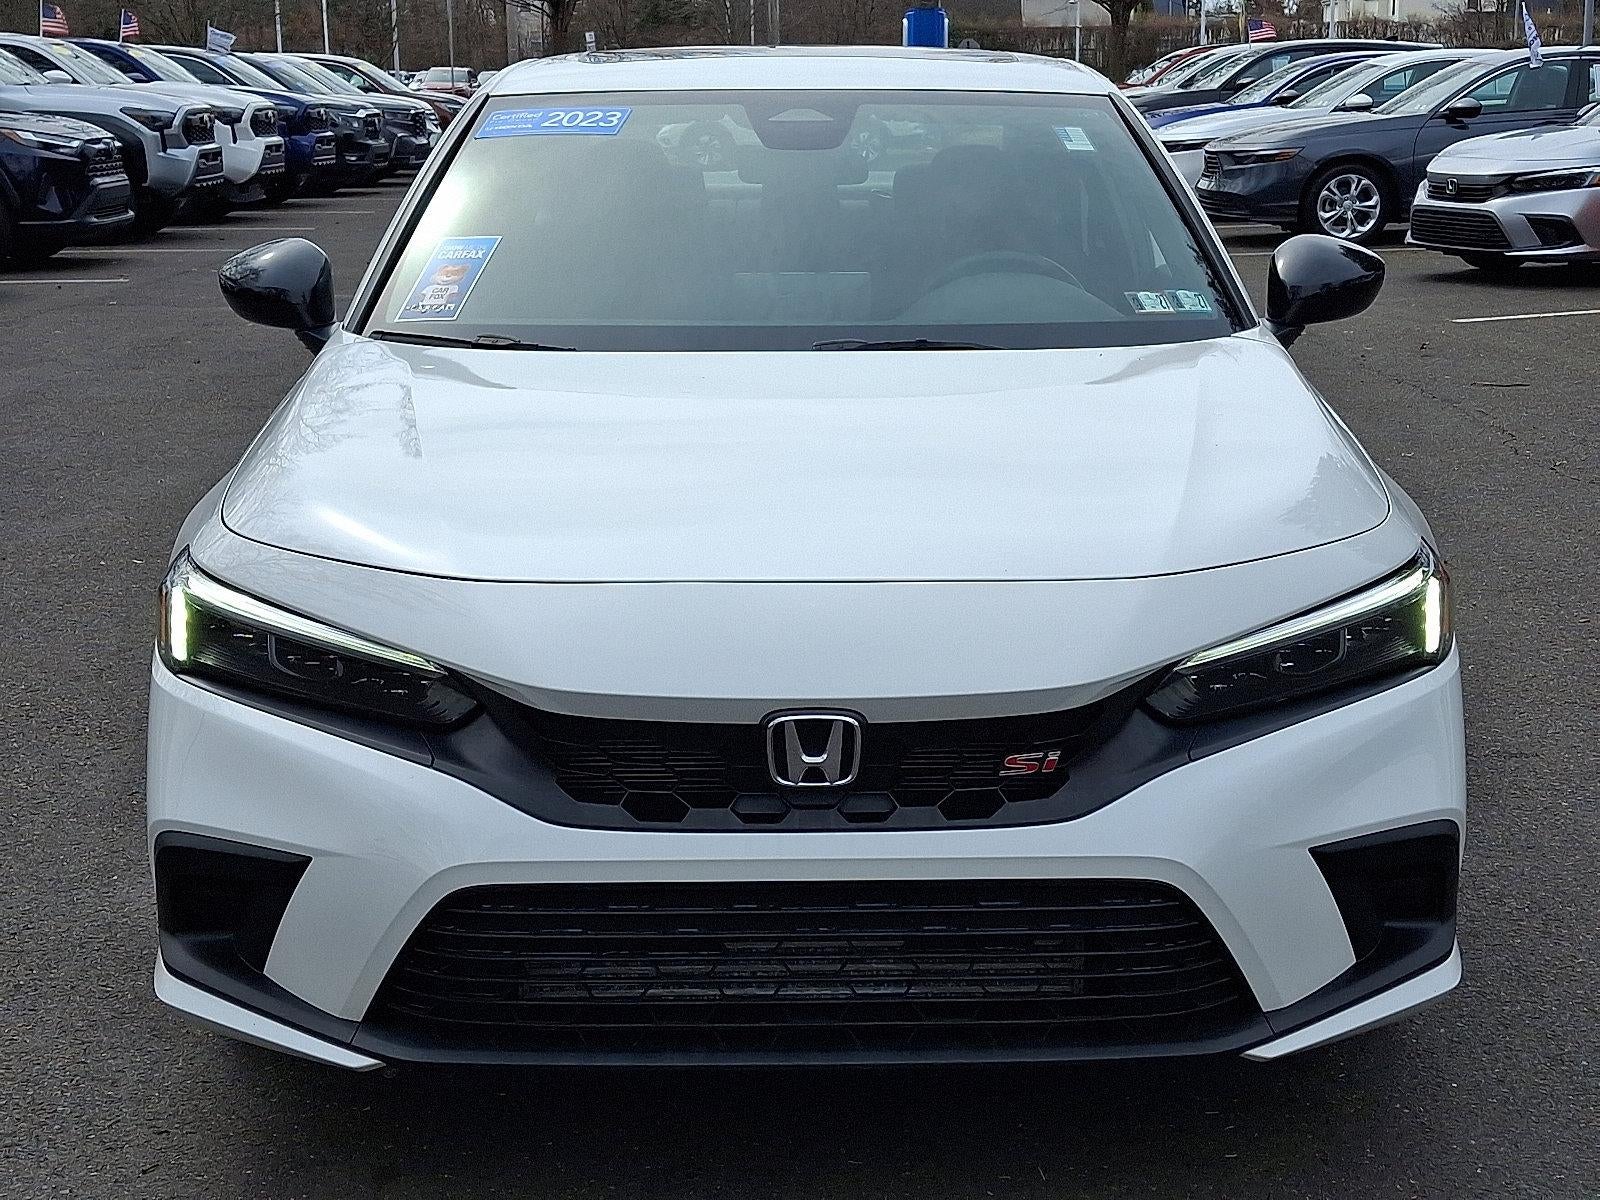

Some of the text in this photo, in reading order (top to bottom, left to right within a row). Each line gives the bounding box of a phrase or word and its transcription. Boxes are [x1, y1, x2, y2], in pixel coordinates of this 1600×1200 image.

[492, 111, 544, 121] Certified
[540, 111, 622, 128] 2023
[437, 249, 487, 260] CARFAX
[431, 287, 450, 295] CAR
[998, 750, 1062, 777] Si
